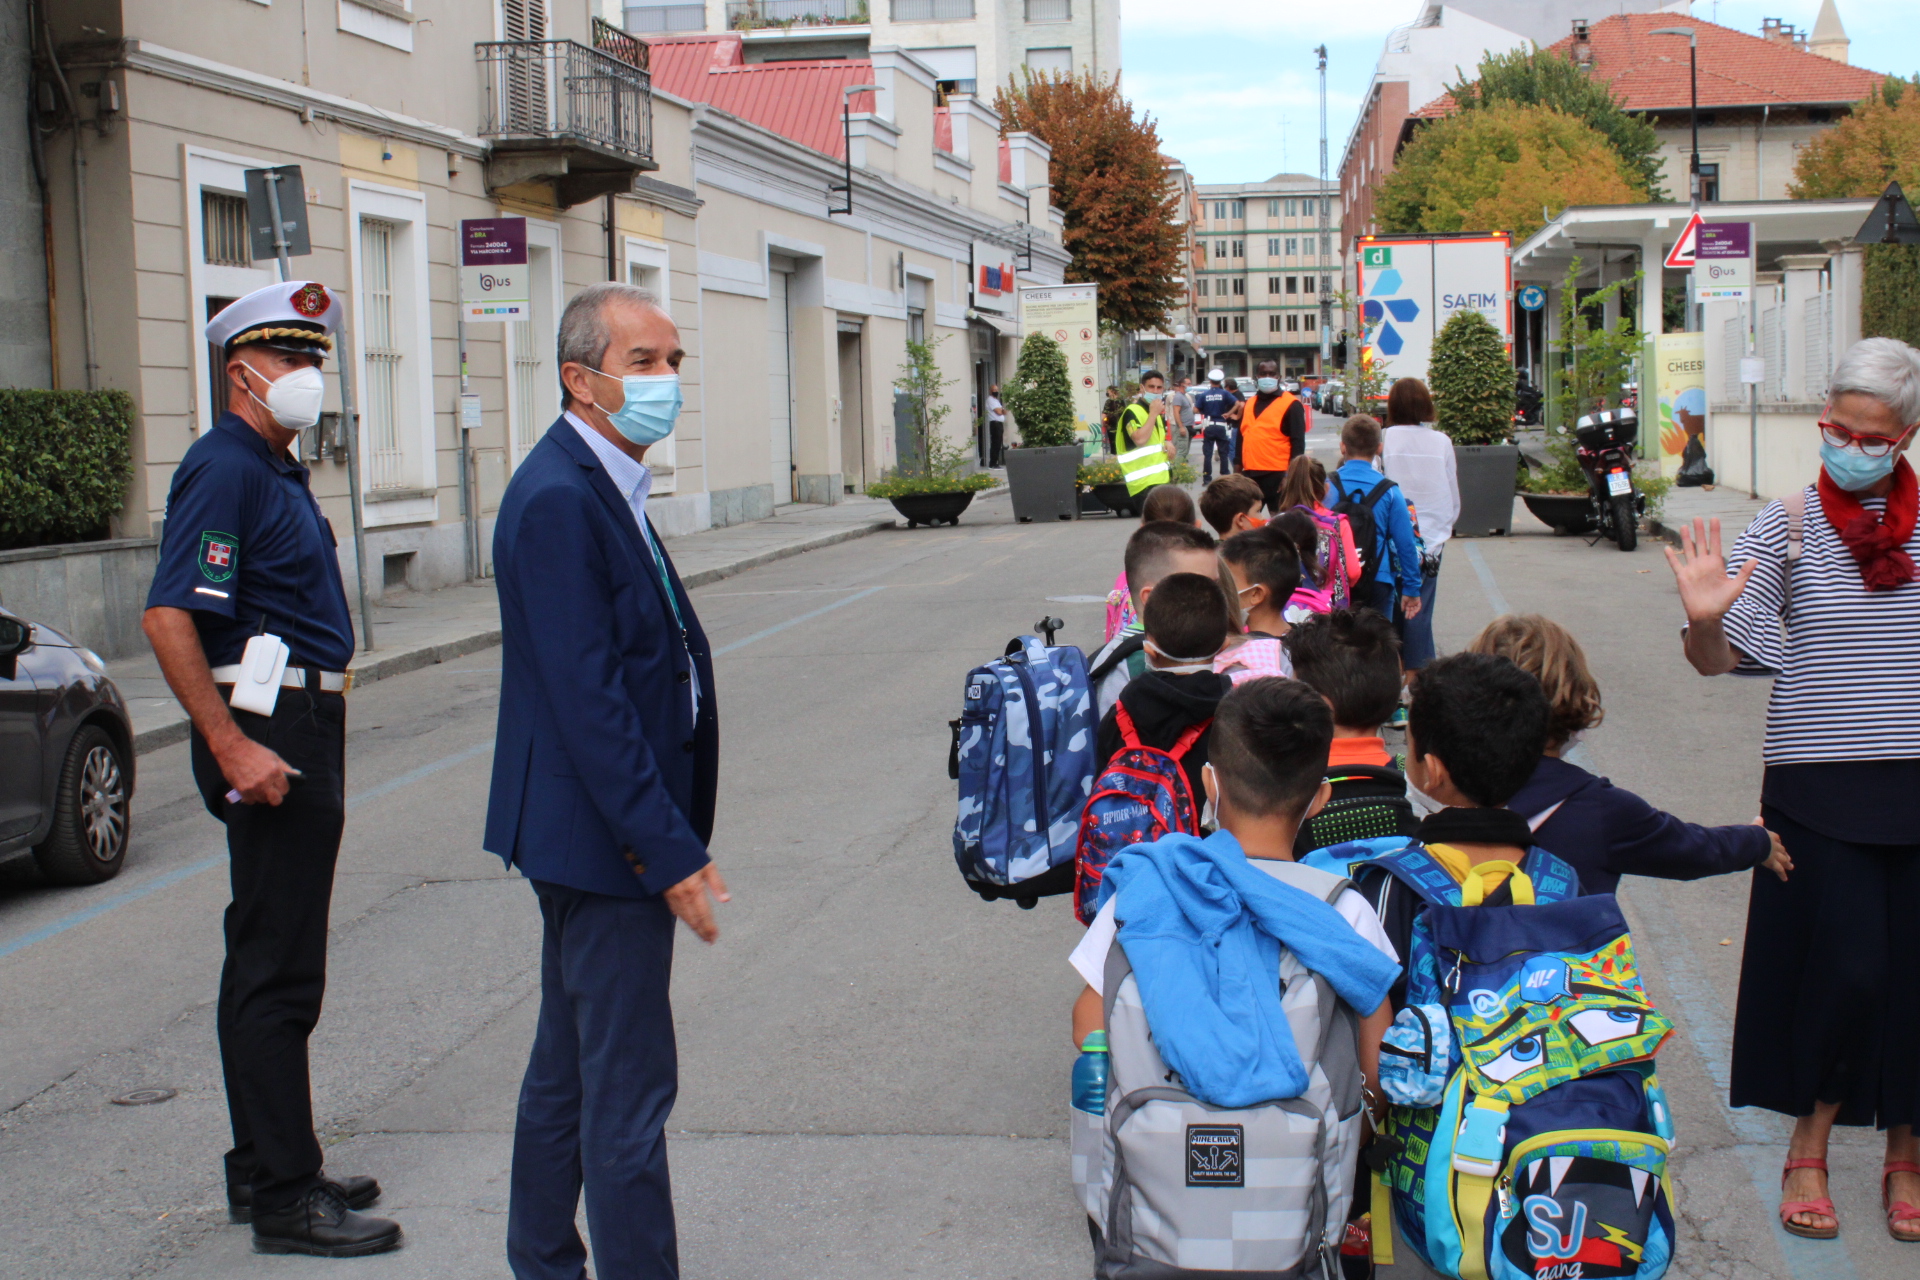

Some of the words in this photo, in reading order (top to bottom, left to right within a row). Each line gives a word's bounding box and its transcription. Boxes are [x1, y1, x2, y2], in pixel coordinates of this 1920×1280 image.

[1372, 249, 1383, 264] d
[1025, 292, 1052, 300] CHEESE
[1443, 293, 1496, 309] SAFIM
[1667, 360, 1705, 373] CHEES
[1103, 804, 1149, 825] SPIDER-MAN
[1525, 968, 1558, 988] HI!
[1191, 1134, 1239, 1145] MINECRAFT
[1535, 1261, 1584, 1280] gang
